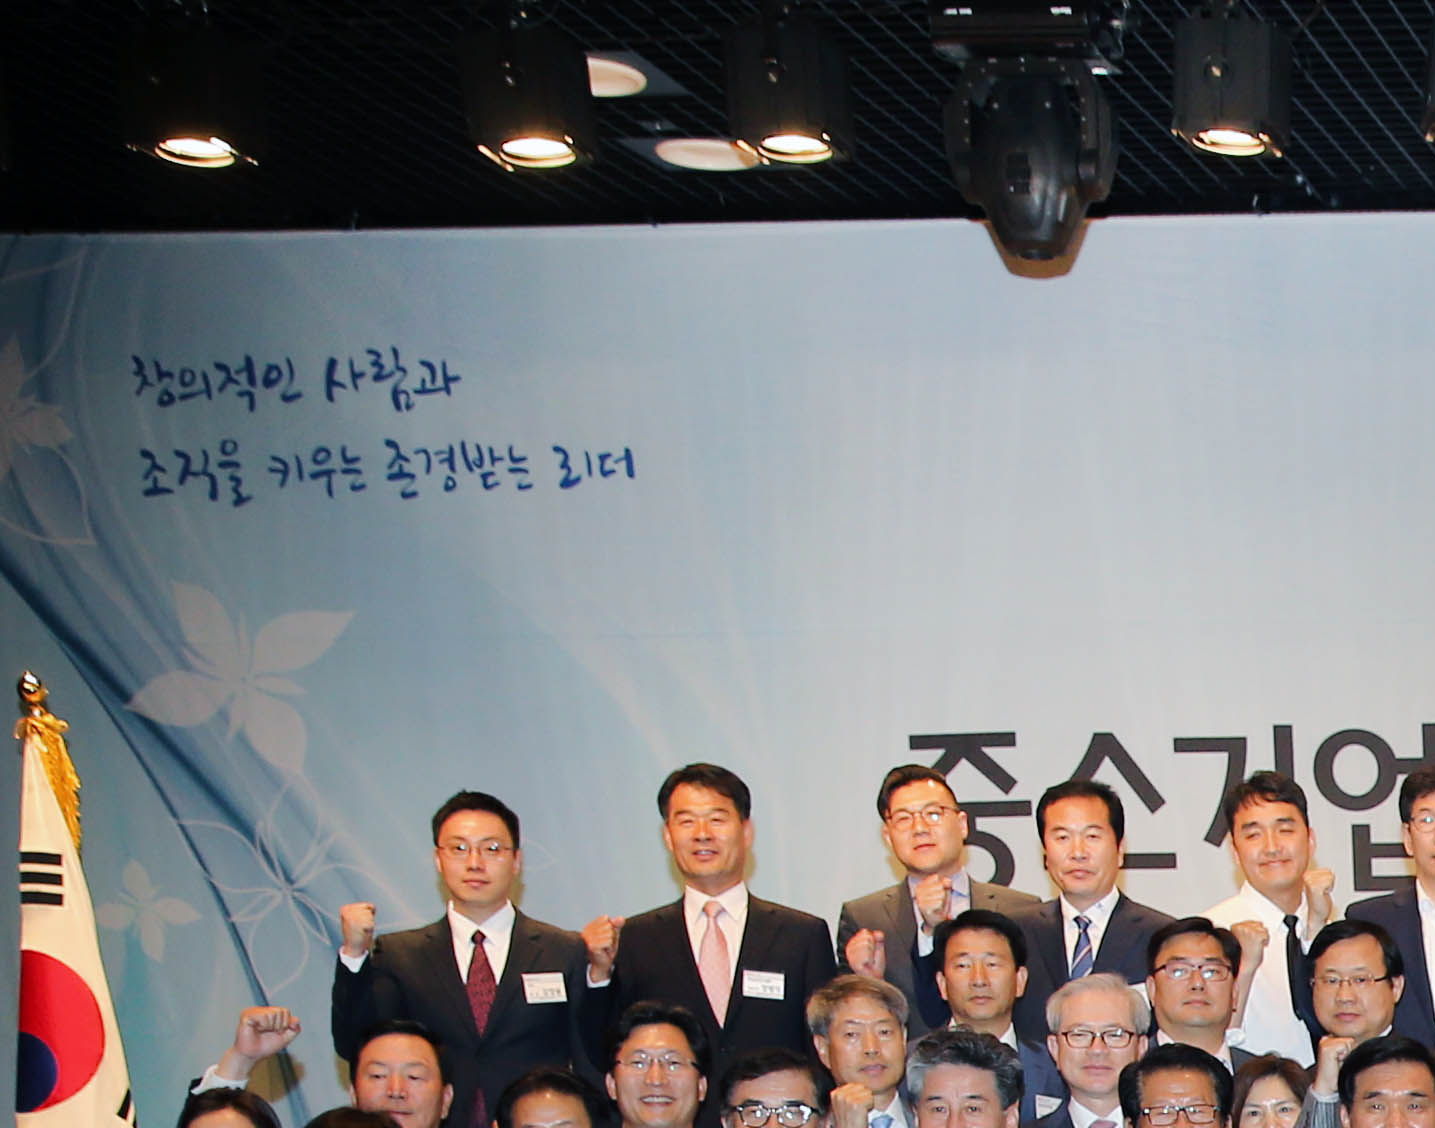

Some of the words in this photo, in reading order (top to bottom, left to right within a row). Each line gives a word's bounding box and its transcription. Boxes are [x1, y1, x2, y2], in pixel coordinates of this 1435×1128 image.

[131, 354, 303, 413] 창의적인
[324, 346, 462, 412] 사람과
[140, 438, 253, 507] 조직을
[267, 444, 368, 499] 키우는
[384, 437, 534, 500] 존경받는
[552, 444, 637, 488] 리더
